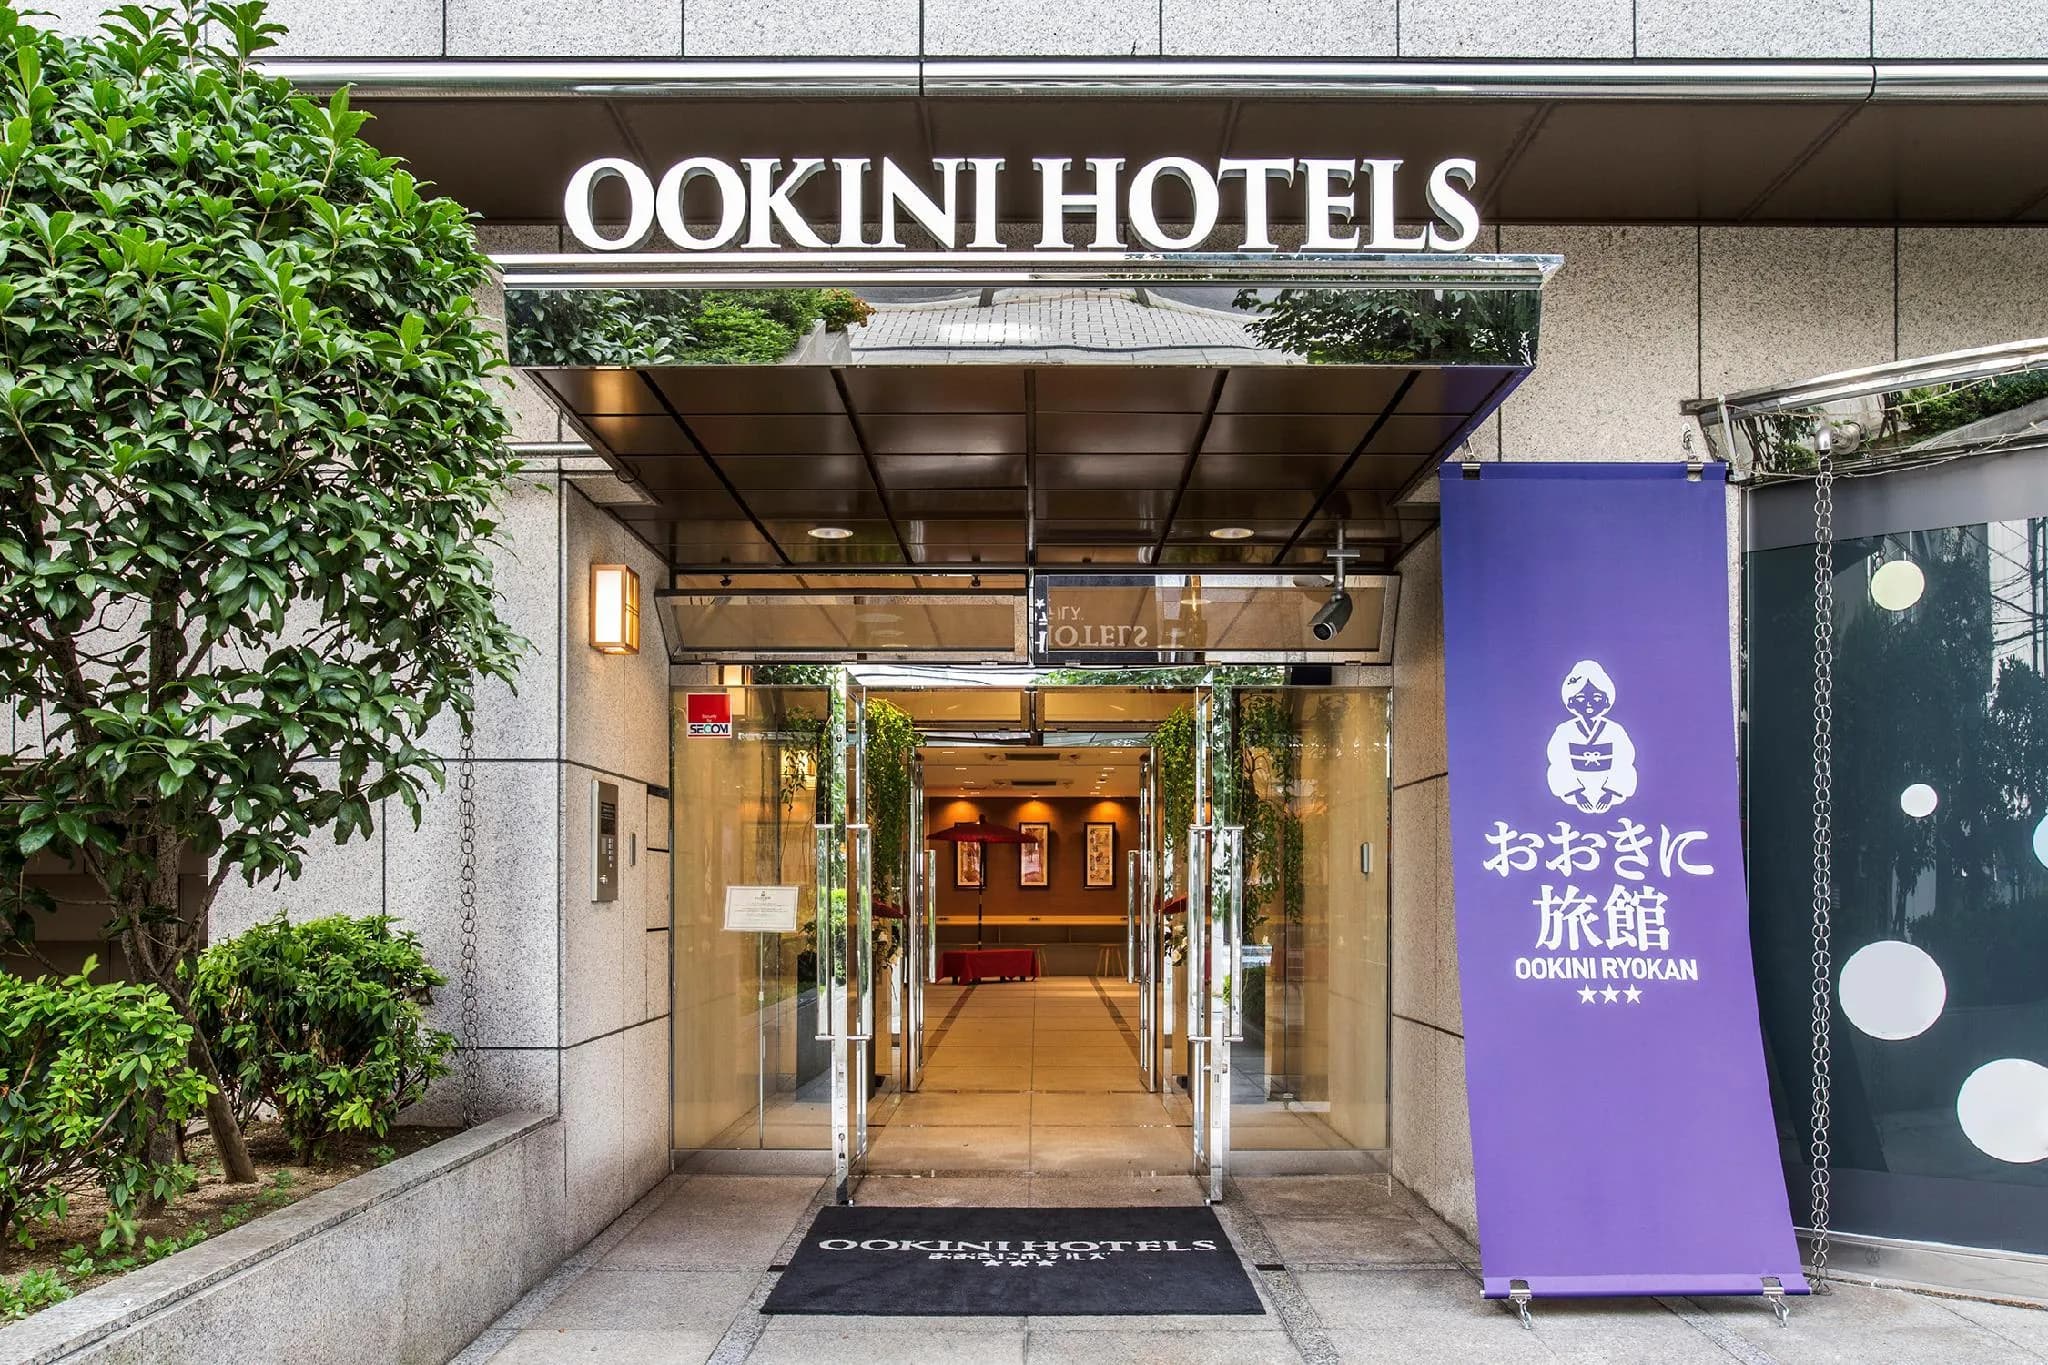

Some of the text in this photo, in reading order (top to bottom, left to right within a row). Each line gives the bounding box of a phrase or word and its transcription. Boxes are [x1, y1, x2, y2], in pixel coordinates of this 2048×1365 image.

[564, 156, 1479, 252] OOKINI HOTELS
[690, 724, 729, 734] SECOM
[1482, 817, 1715, 881] おおきに
[1532, 883, 1671, 951] 旅館
[1515, 957, 1699, 981] OOKINI RYOKAN
[818, 1239, 1217, 1252] OOKINI HOTELS
